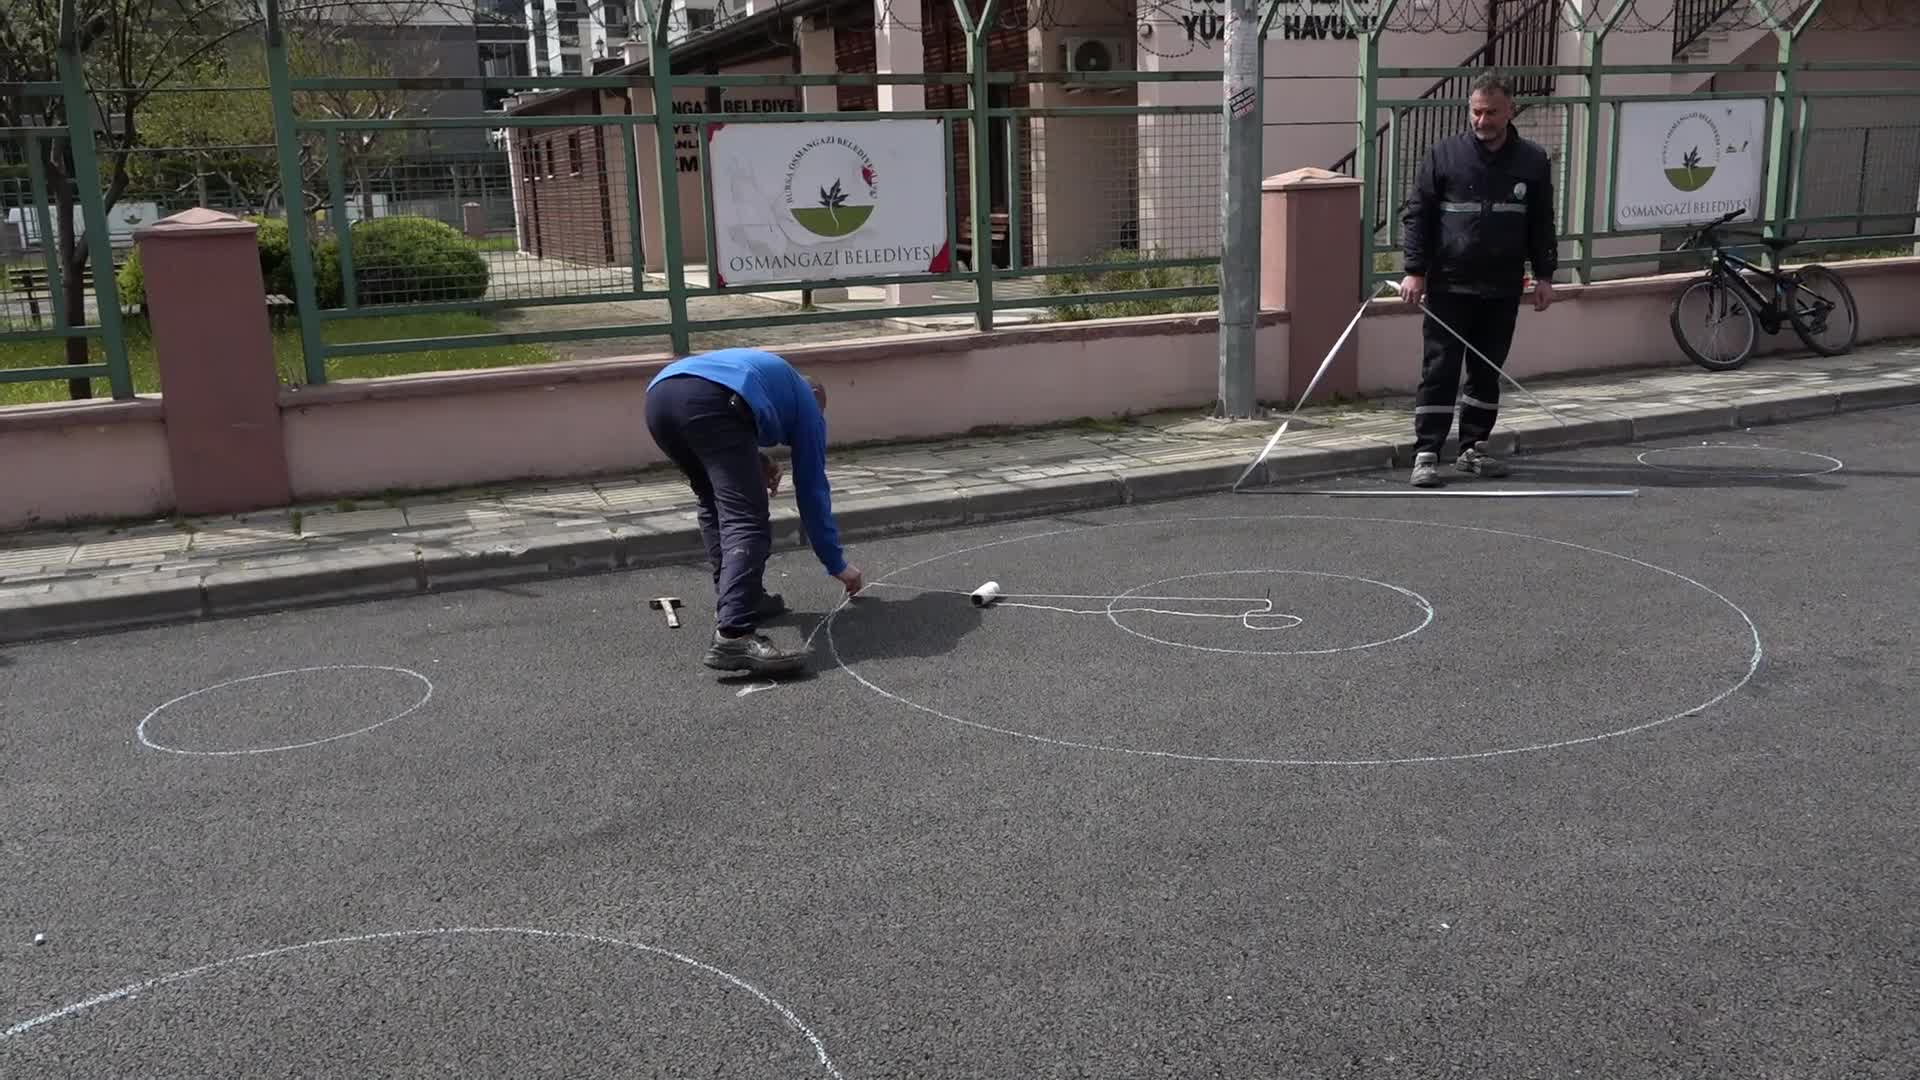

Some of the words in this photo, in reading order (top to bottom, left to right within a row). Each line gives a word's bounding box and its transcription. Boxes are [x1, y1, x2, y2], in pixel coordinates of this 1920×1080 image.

[1621, 201, 1691, 218] OSMANGAZİ
[1693, 197, 1752, 214] BELEDİYESİ
[730, 252, 839, 272] OSMANGAZİ
[844, 244, 936, 265] BELEDİYESİ
